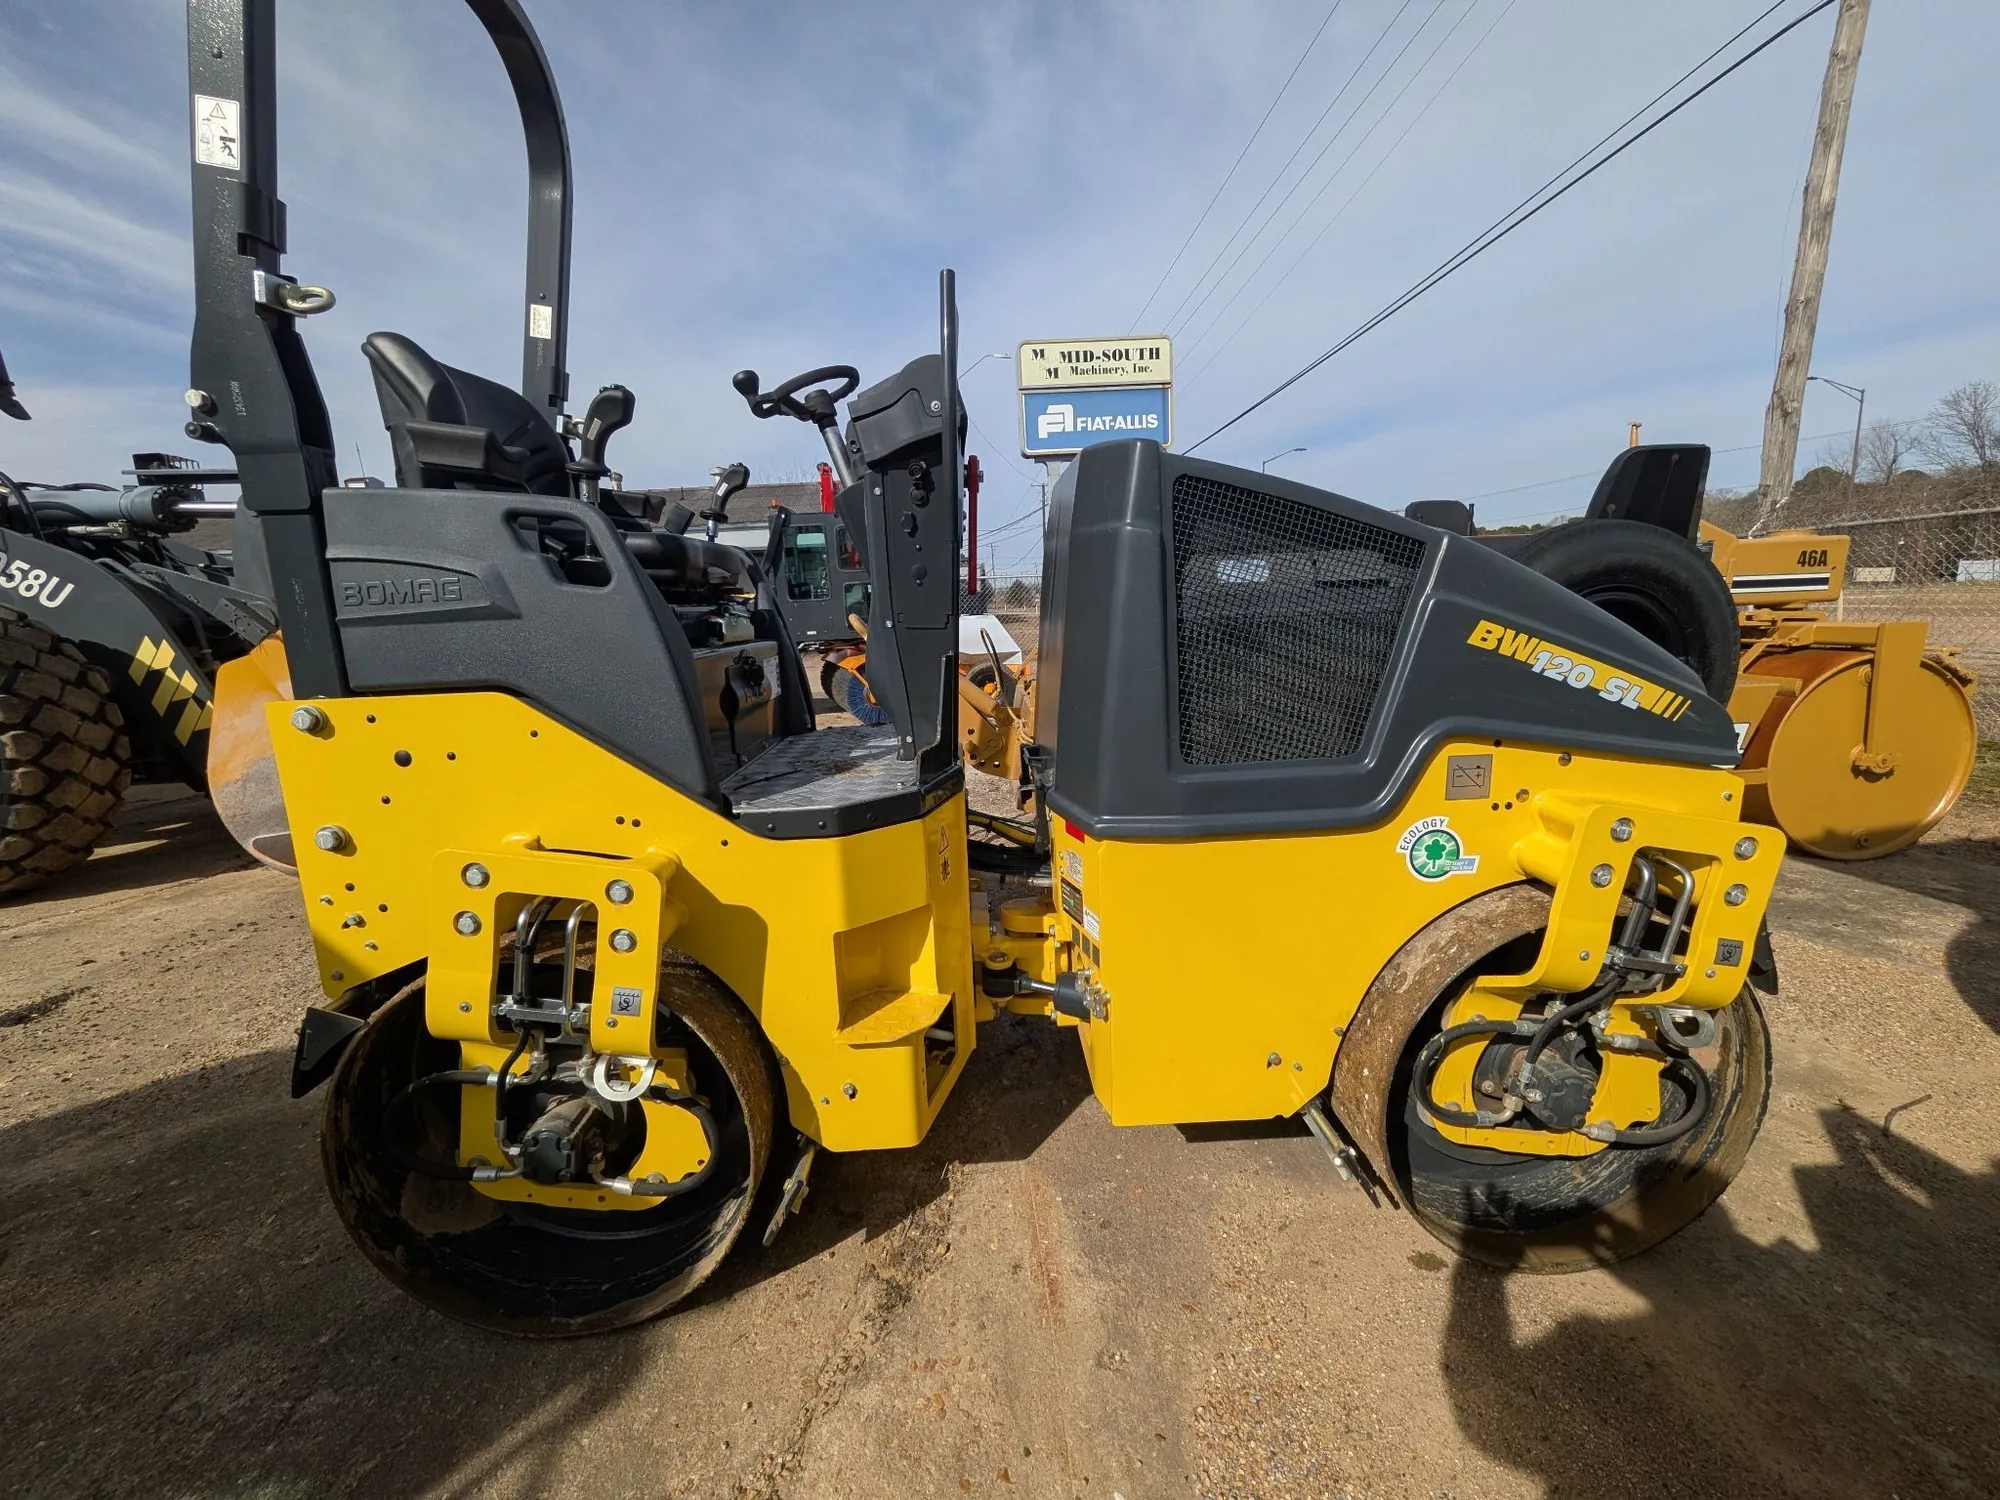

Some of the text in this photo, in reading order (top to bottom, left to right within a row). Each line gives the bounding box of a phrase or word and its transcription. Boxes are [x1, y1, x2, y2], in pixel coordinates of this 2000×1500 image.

[1059, 347, 1161, 364] MID-SOUTH
[1069, 363, 1153, 377] Machinery, Inc.
[1076, 413, 1159, 432] FIAT-ALLIS
[1796, 549, 1828, 568] 46A
[341, 577, 463, 607] BOMAG
[1598, 677, 1643, 710] SL
[1399, 818, 1446, 851] ECOLOGY
